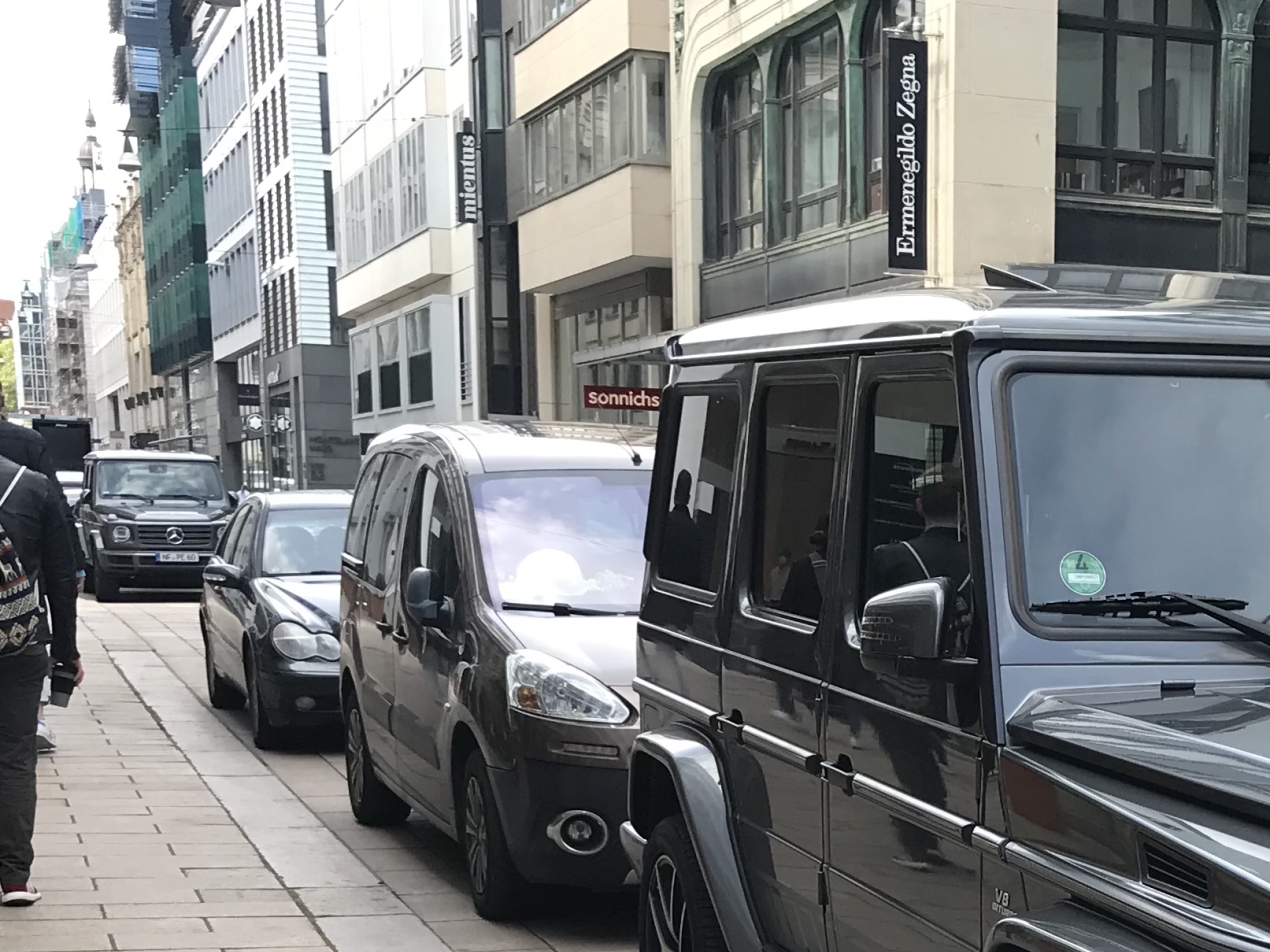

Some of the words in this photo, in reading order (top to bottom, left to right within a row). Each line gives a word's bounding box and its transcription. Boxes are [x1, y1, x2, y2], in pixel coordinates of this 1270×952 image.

[896, 53, 921, 119] Zegna
[459, 135, 477, 219] mientus
[896, 123, 921, 257] Ermenegildo
[588, 390, 660, 407] sonnichs
[995, 888, 1009, 906] V8
